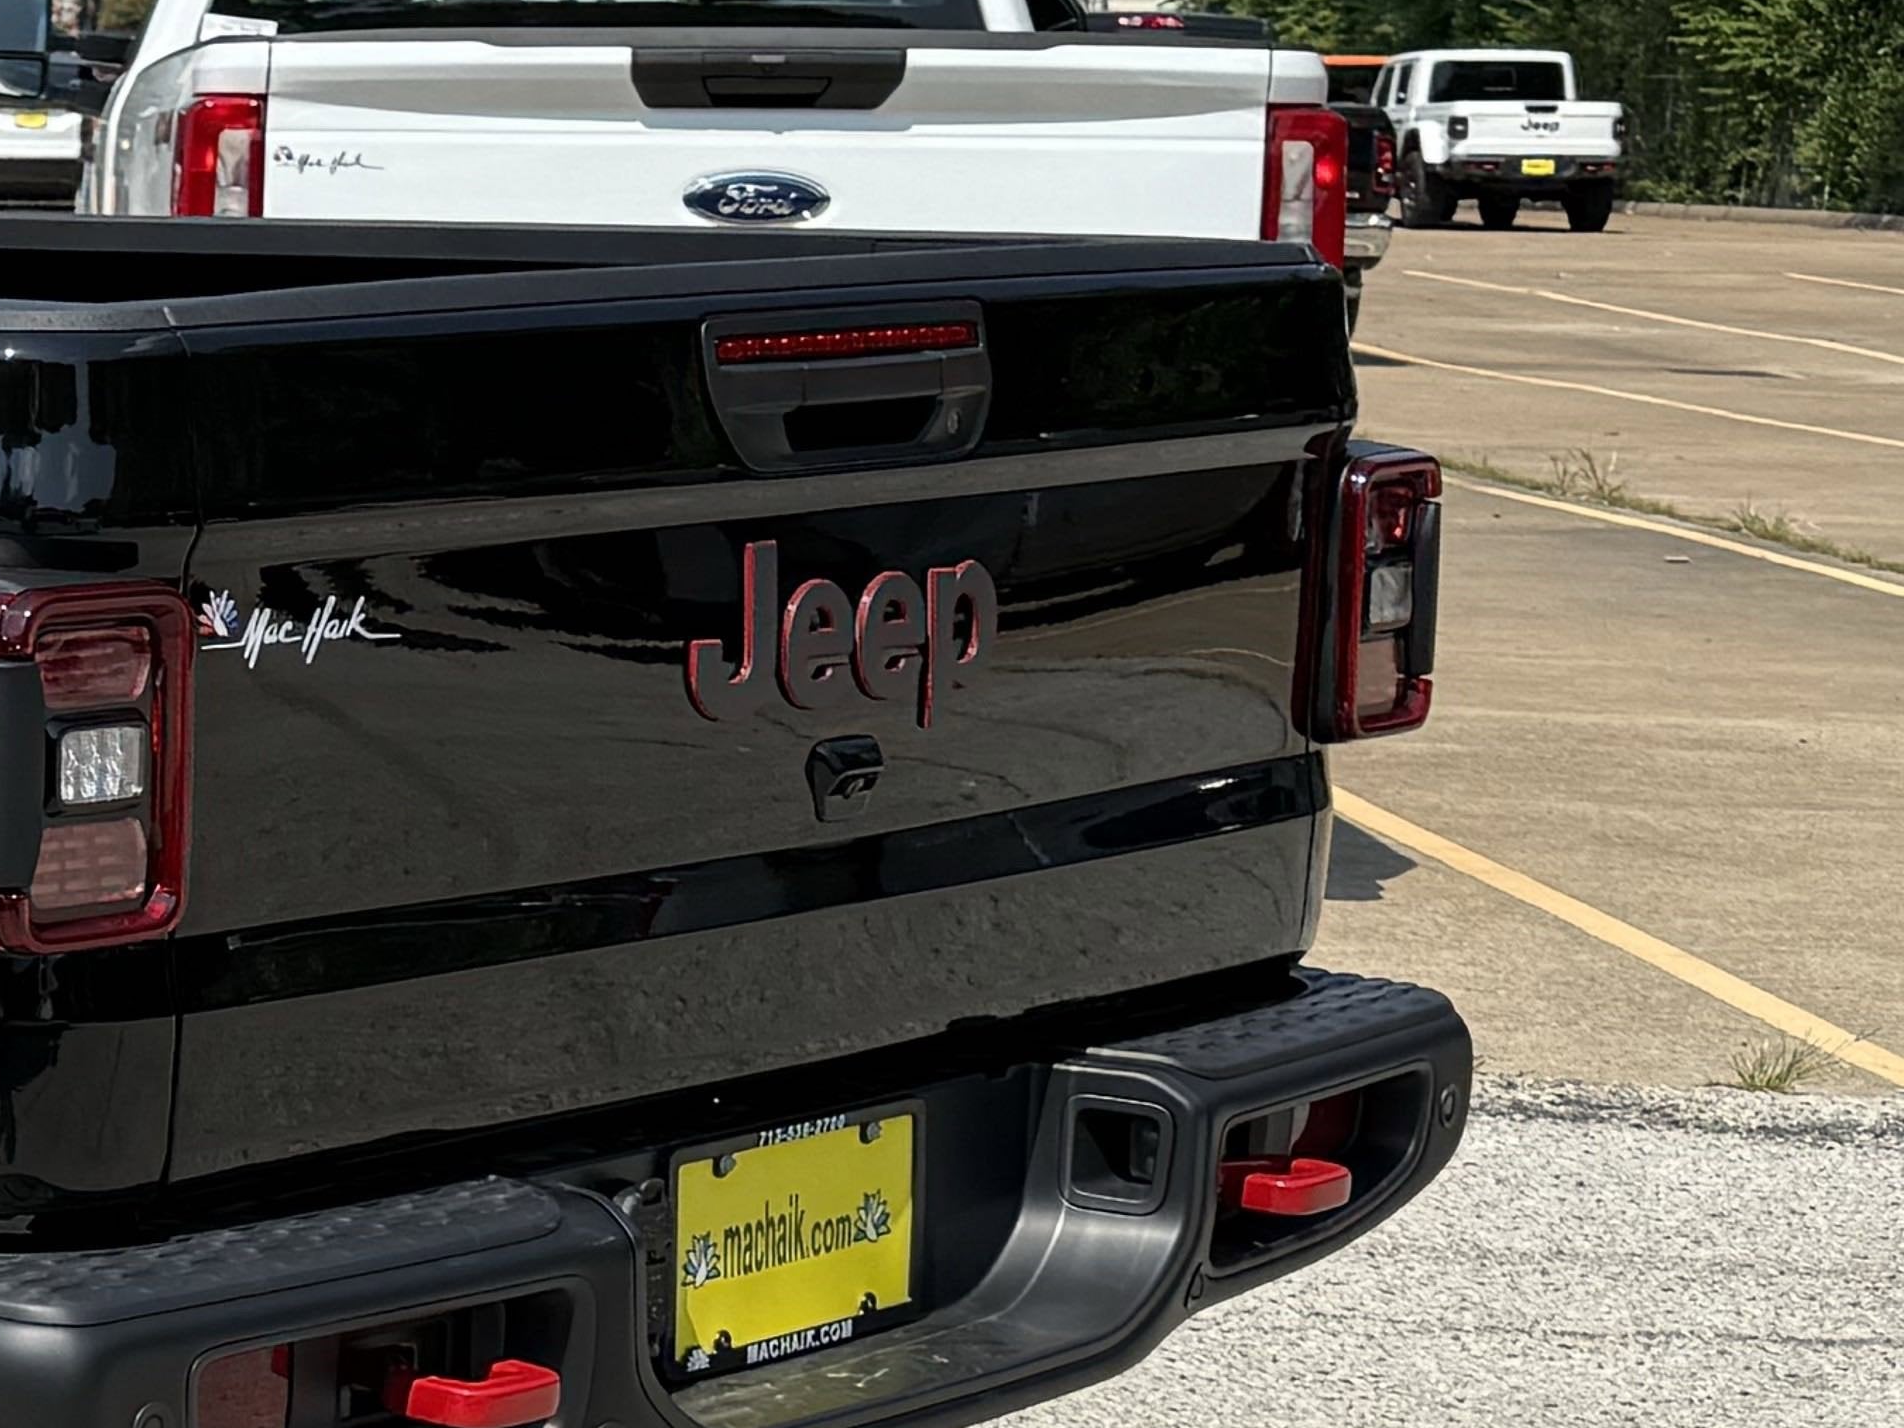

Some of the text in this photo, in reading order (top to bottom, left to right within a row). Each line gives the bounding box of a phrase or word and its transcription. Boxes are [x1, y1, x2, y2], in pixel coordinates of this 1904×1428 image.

[718, 183, 794, 215] Ford
[201, 594, 402, 669] Mac Haik
[684, 539, 998, 730] Jeep
[723, 1193, 852, 1280] machaik.com
[745, 1318, 854, 1365] MACHAIK.COM
